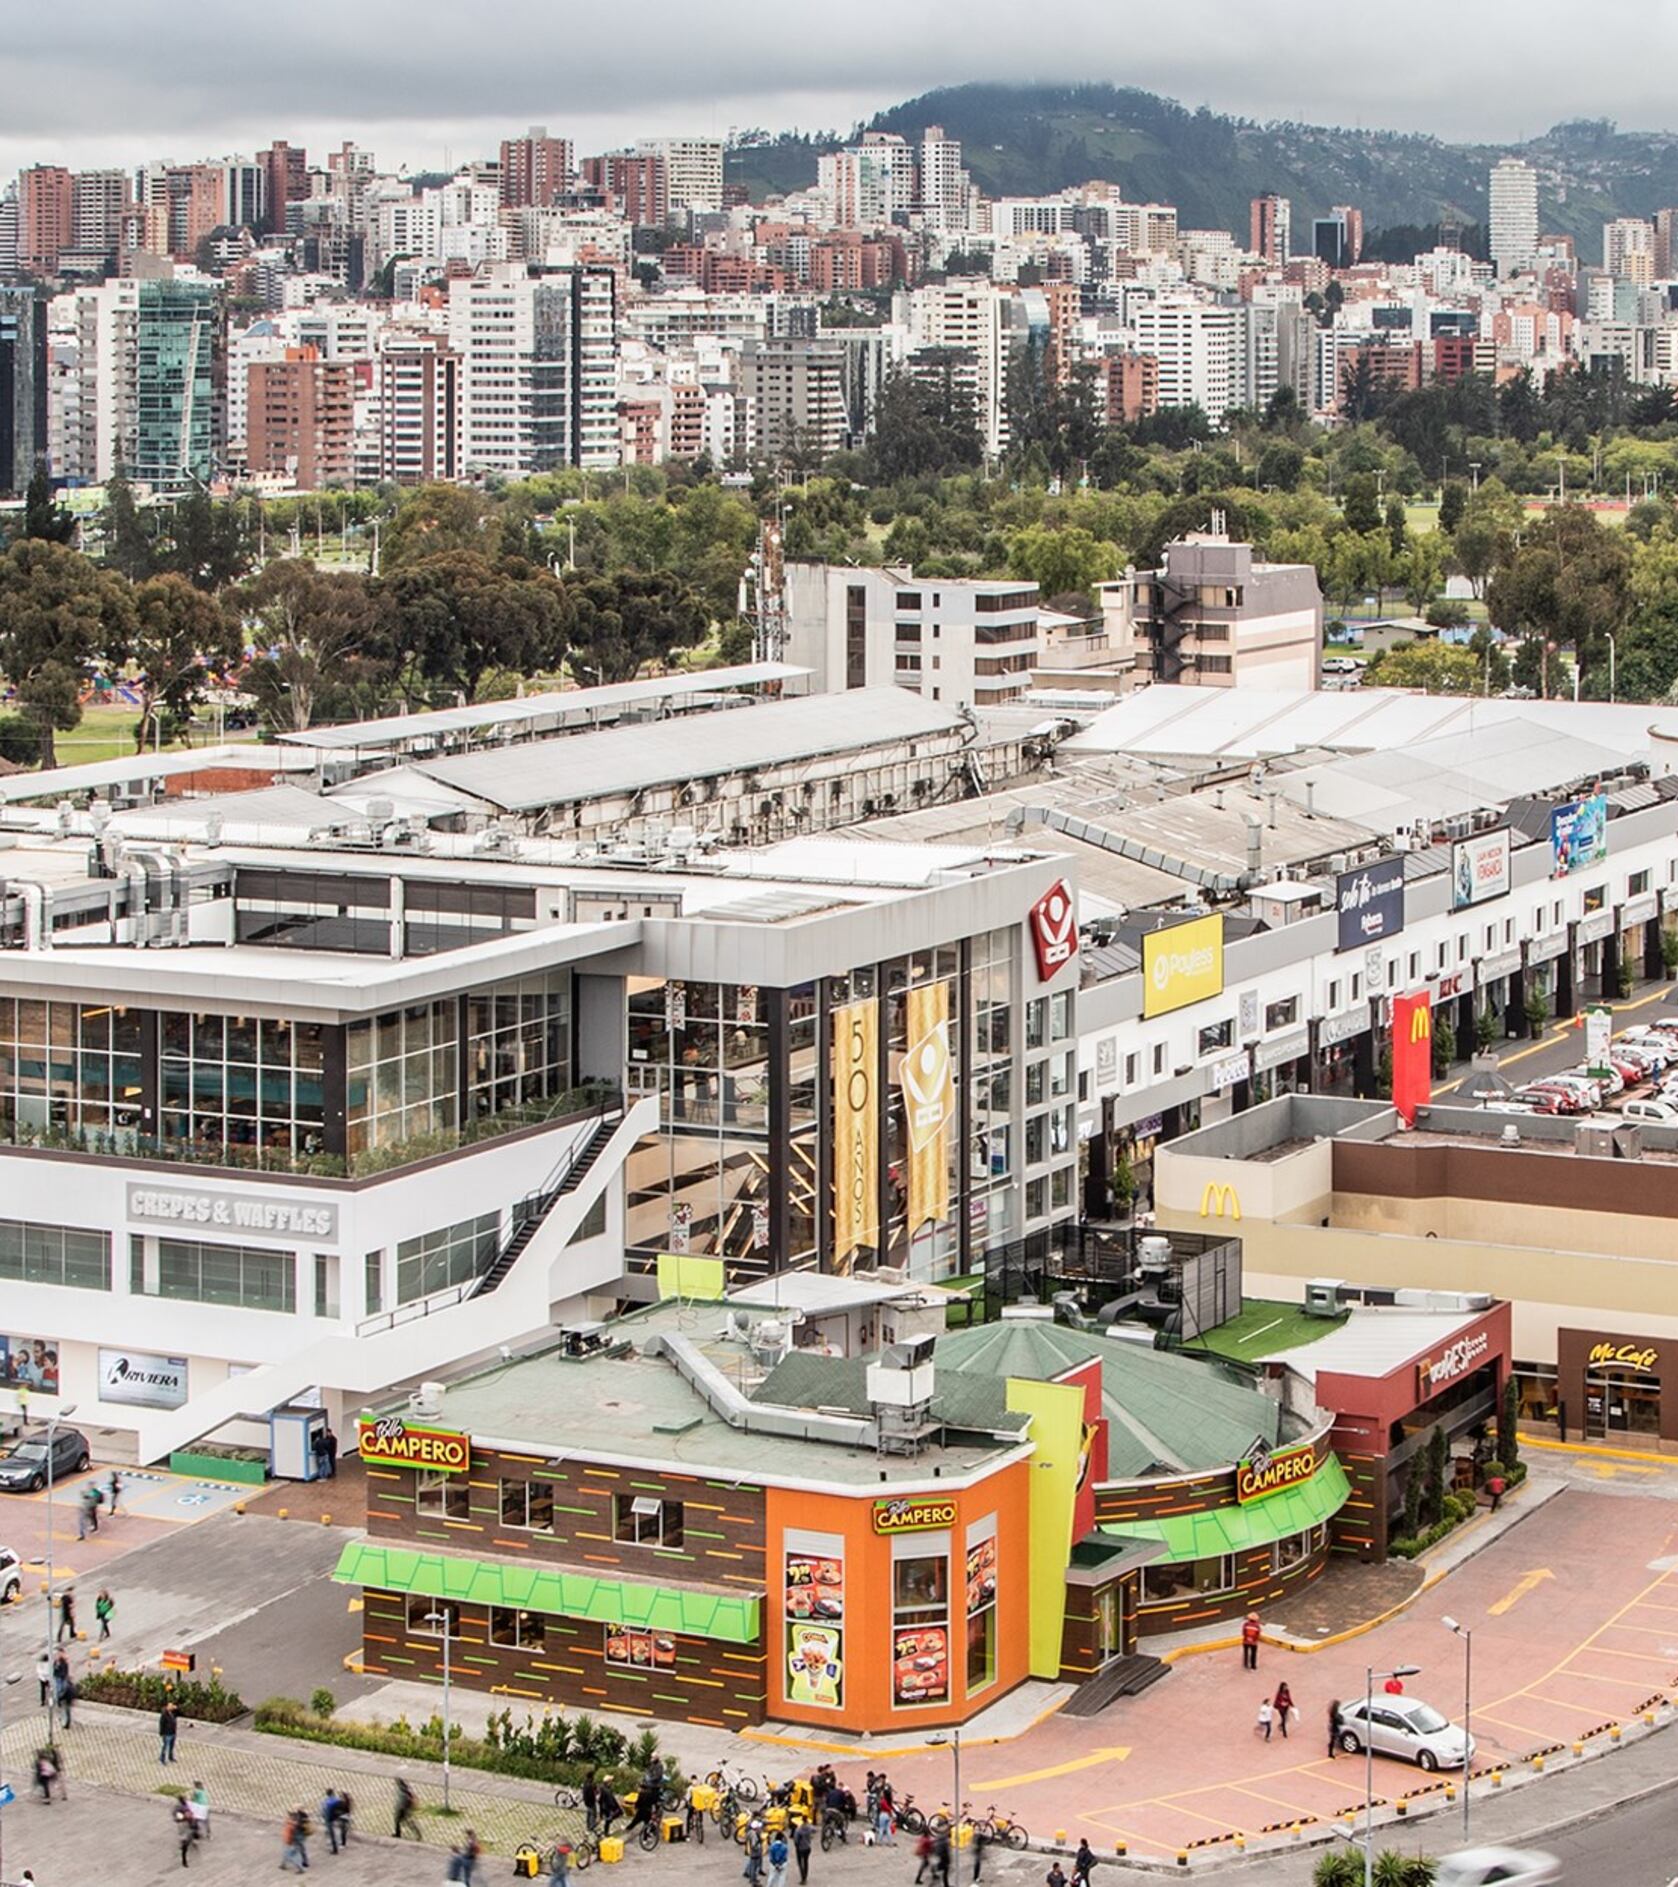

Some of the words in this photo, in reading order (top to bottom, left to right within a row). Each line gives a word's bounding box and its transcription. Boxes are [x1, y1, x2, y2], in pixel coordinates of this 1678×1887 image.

[131, 1190, 210, 1222] CREPES
[212, 1200, 231, 1224] &
[234, 1201, 331, 1236] WAFFLES
[125, 1371, 180, 1388] RIVIERA
[361, 1431, 464, 1464] CAMPERO
[1241, 1453, 1314, 1494] CAMPERO
[877, 1507, 956, 1528] CAMPERO
